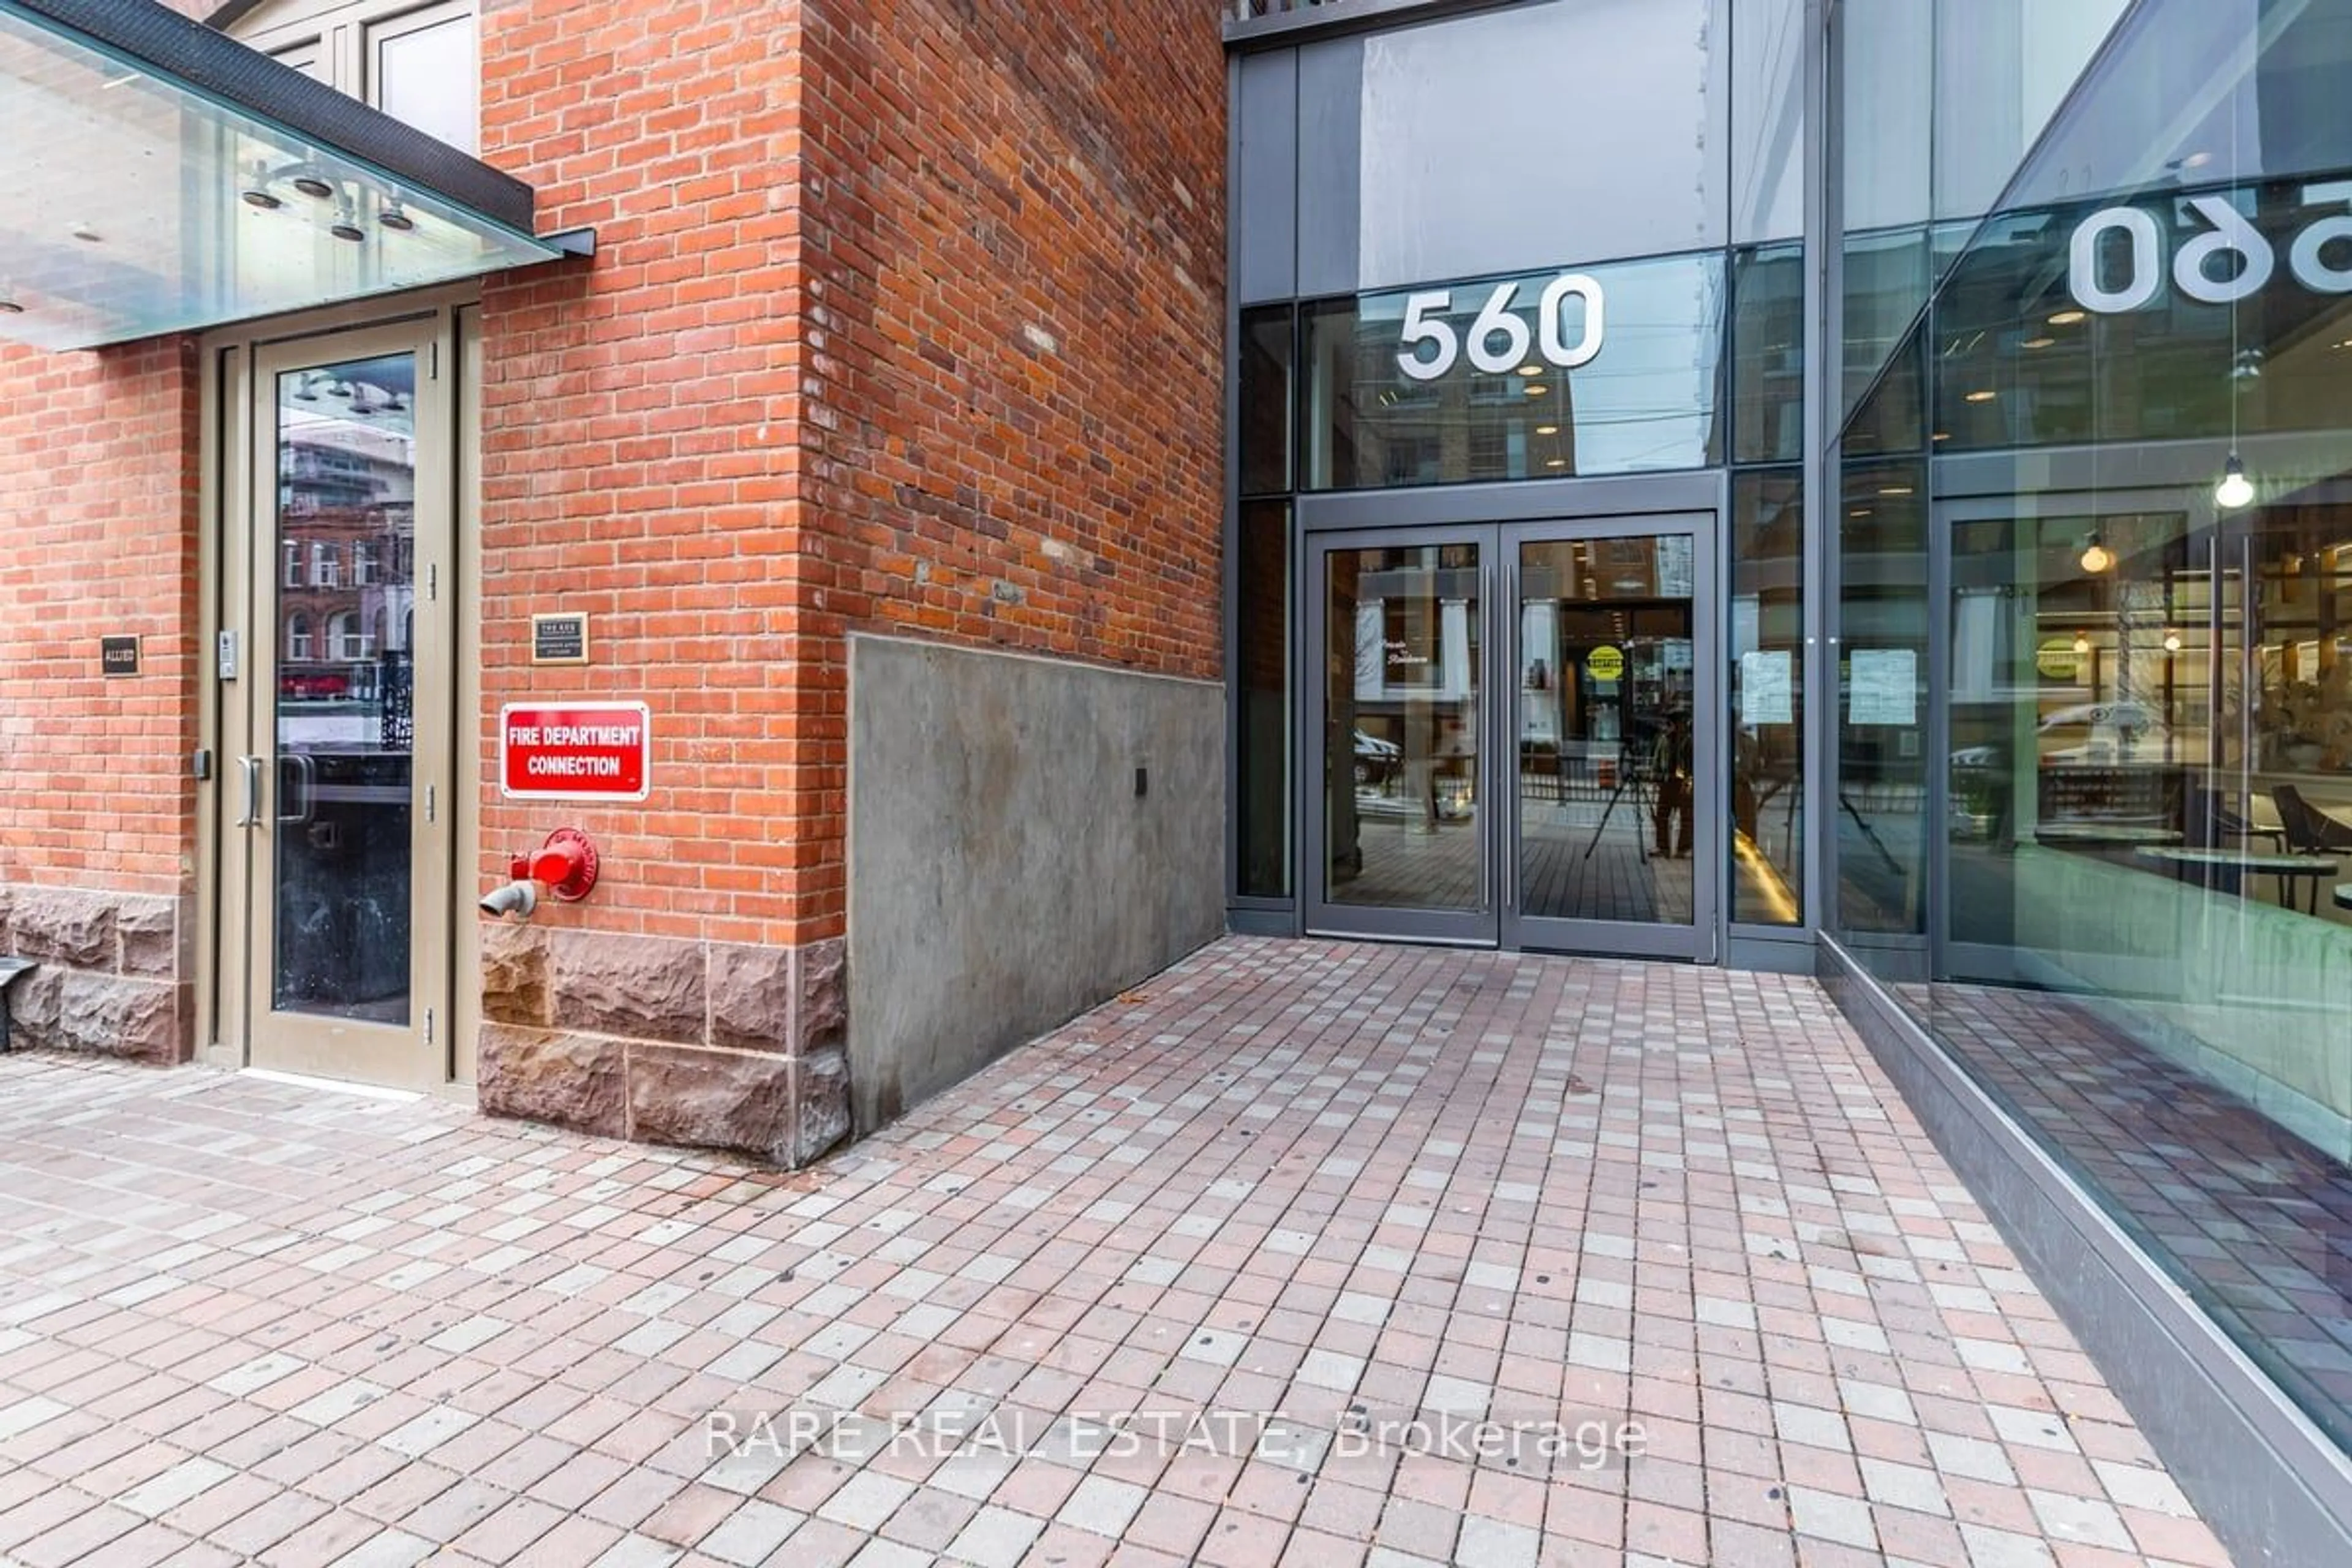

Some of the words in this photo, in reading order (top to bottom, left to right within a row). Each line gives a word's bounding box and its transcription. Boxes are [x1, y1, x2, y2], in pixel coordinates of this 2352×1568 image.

[1396, 274, 1604, 380] 560
[509, 726, 540, 745] FIRE
[543, 726, 640, 745] DEPARTMENT
[527, 755, 620, 775] CONNECTION
